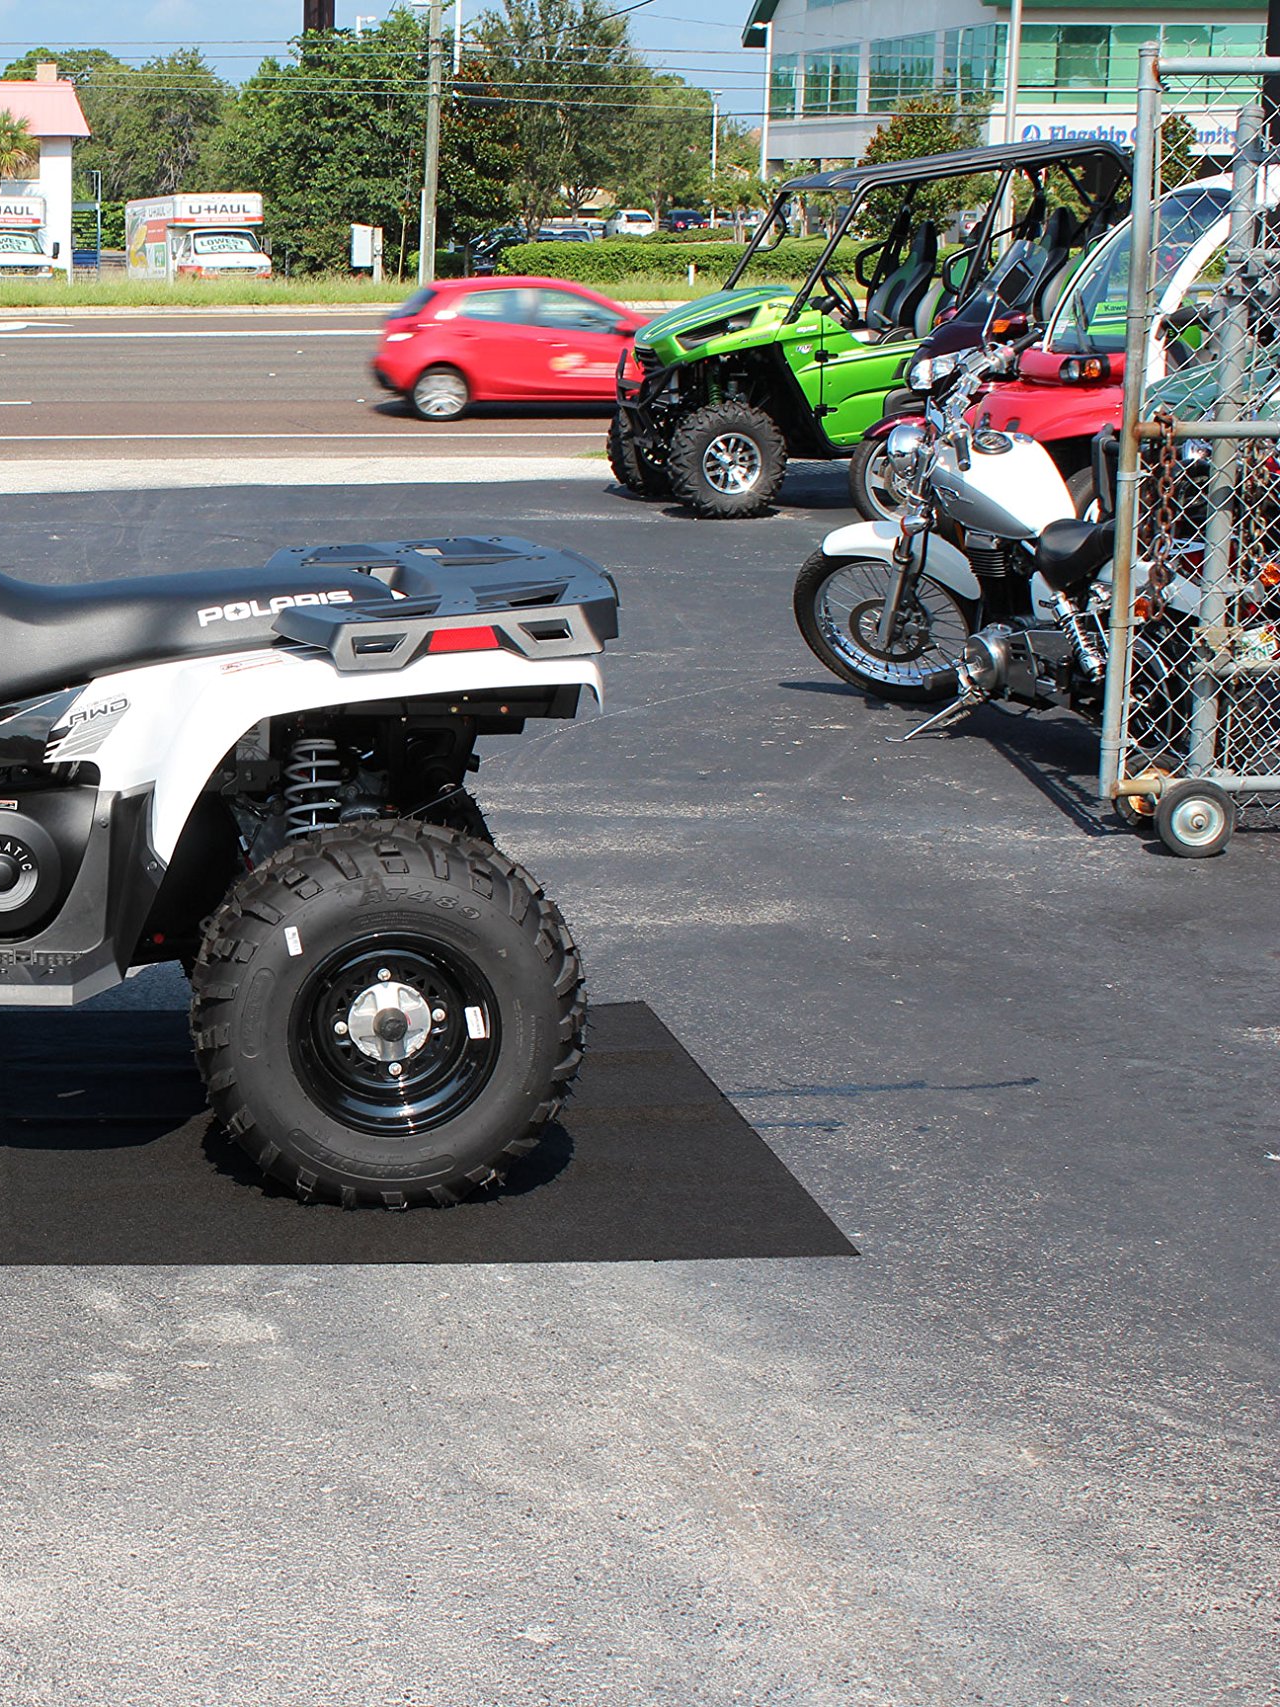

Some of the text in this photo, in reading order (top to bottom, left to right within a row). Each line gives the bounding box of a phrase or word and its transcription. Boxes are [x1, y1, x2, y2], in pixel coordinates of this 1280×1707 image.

[1049, 125, 1127, 144] Flagship
[189, 204, 251, 215] U-HAUL
[200, 238, 245, 247] LOWEST
[210, 243, 240, 251] COST
[196, 590, 353, 627] POLARIS
[70, 698, 128, 725] AWD
